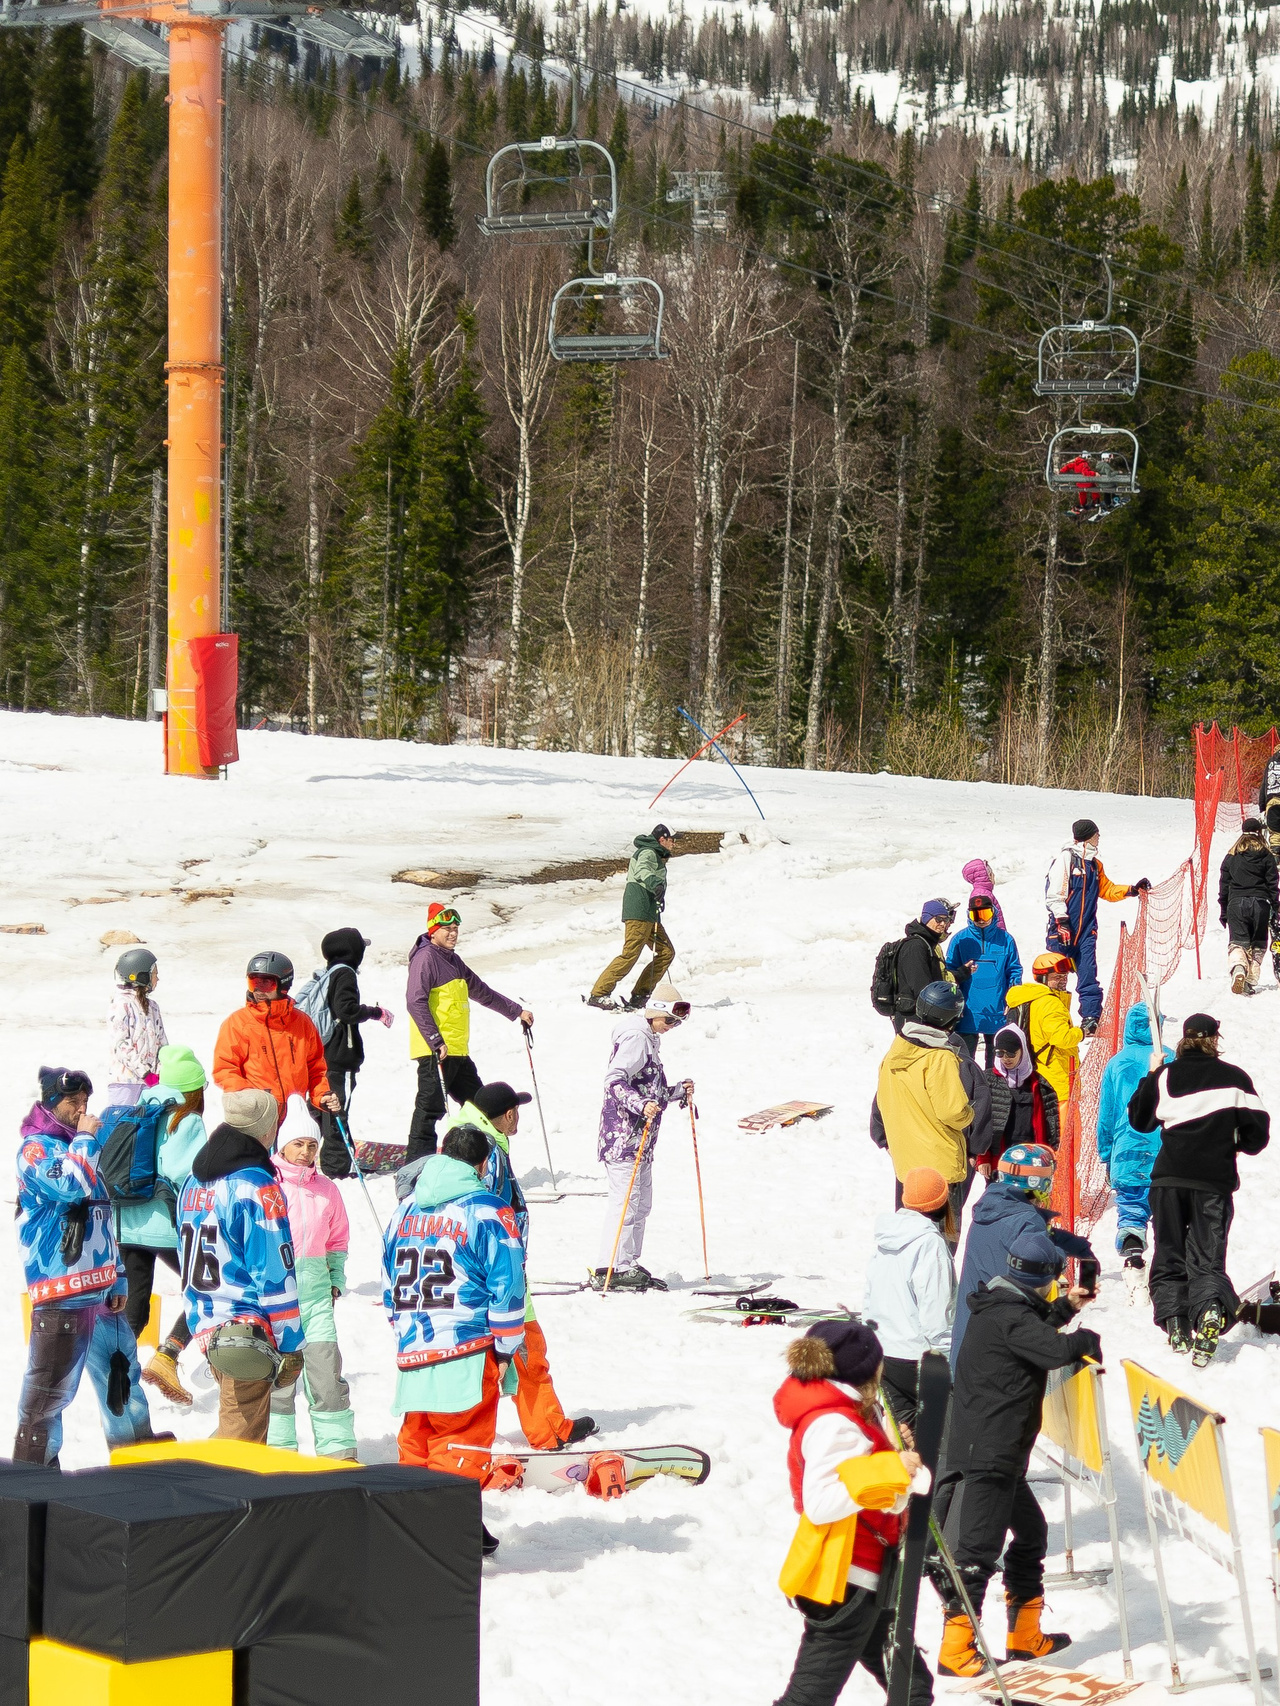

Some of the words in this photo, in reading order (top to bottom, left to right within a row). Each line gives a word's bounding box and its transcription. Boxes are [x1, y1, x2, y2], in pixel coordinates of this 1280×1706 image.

[398, 1215, 468, 1246] ОЦМАН
[68, 1268, 118, 1290] GRELKA
[393, 1247, 457, 1312] 22
